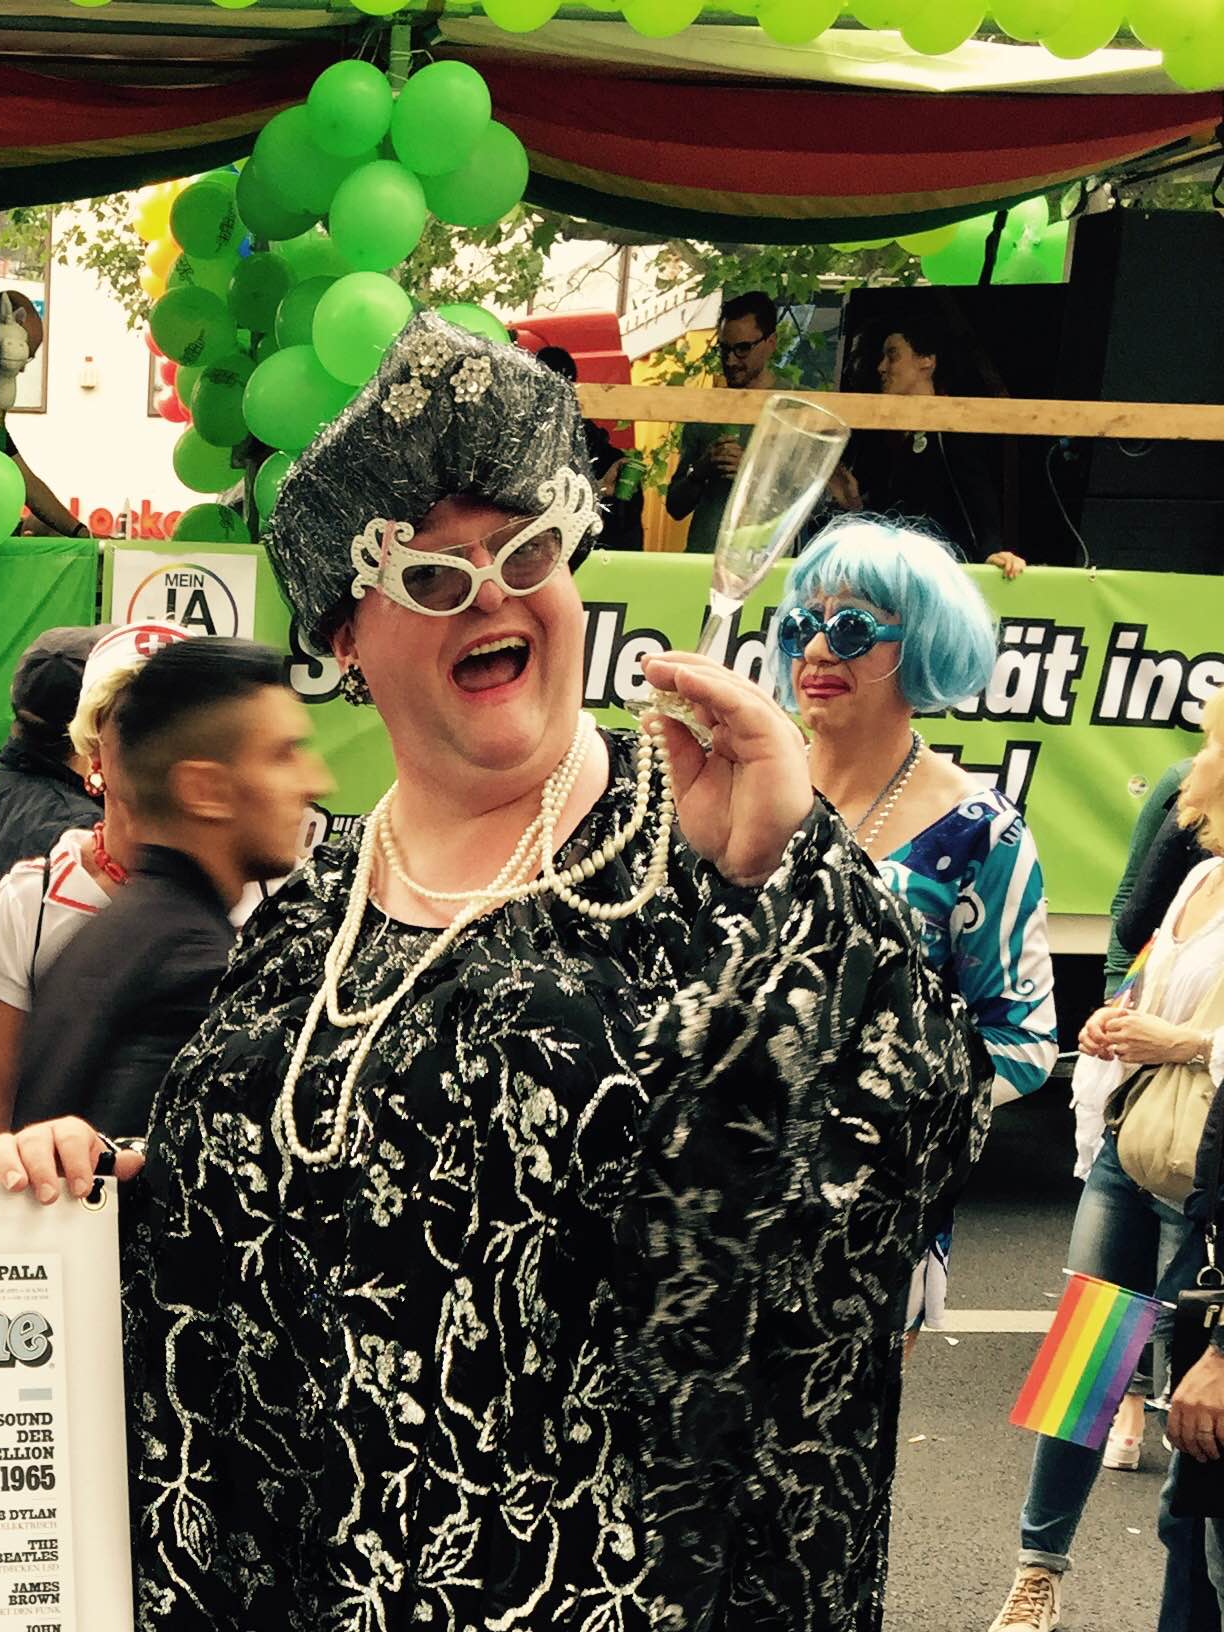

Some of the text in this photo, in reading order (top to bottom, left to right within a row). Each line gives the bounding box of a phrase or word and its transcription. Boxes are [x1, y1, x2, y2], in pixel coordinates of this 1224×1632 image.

[165, 573, 204, 588] MEIN
[16, 1429, 54, 1443] DER
[0, 1465, 56, 1491] 1965
[9, 1508, 57, 1520] DYLAN
[28, 1539, 58, 1550] THE
[11, 1581, 60, 1593] JAMES
[8, 1593, 60, 1606] BROWN
